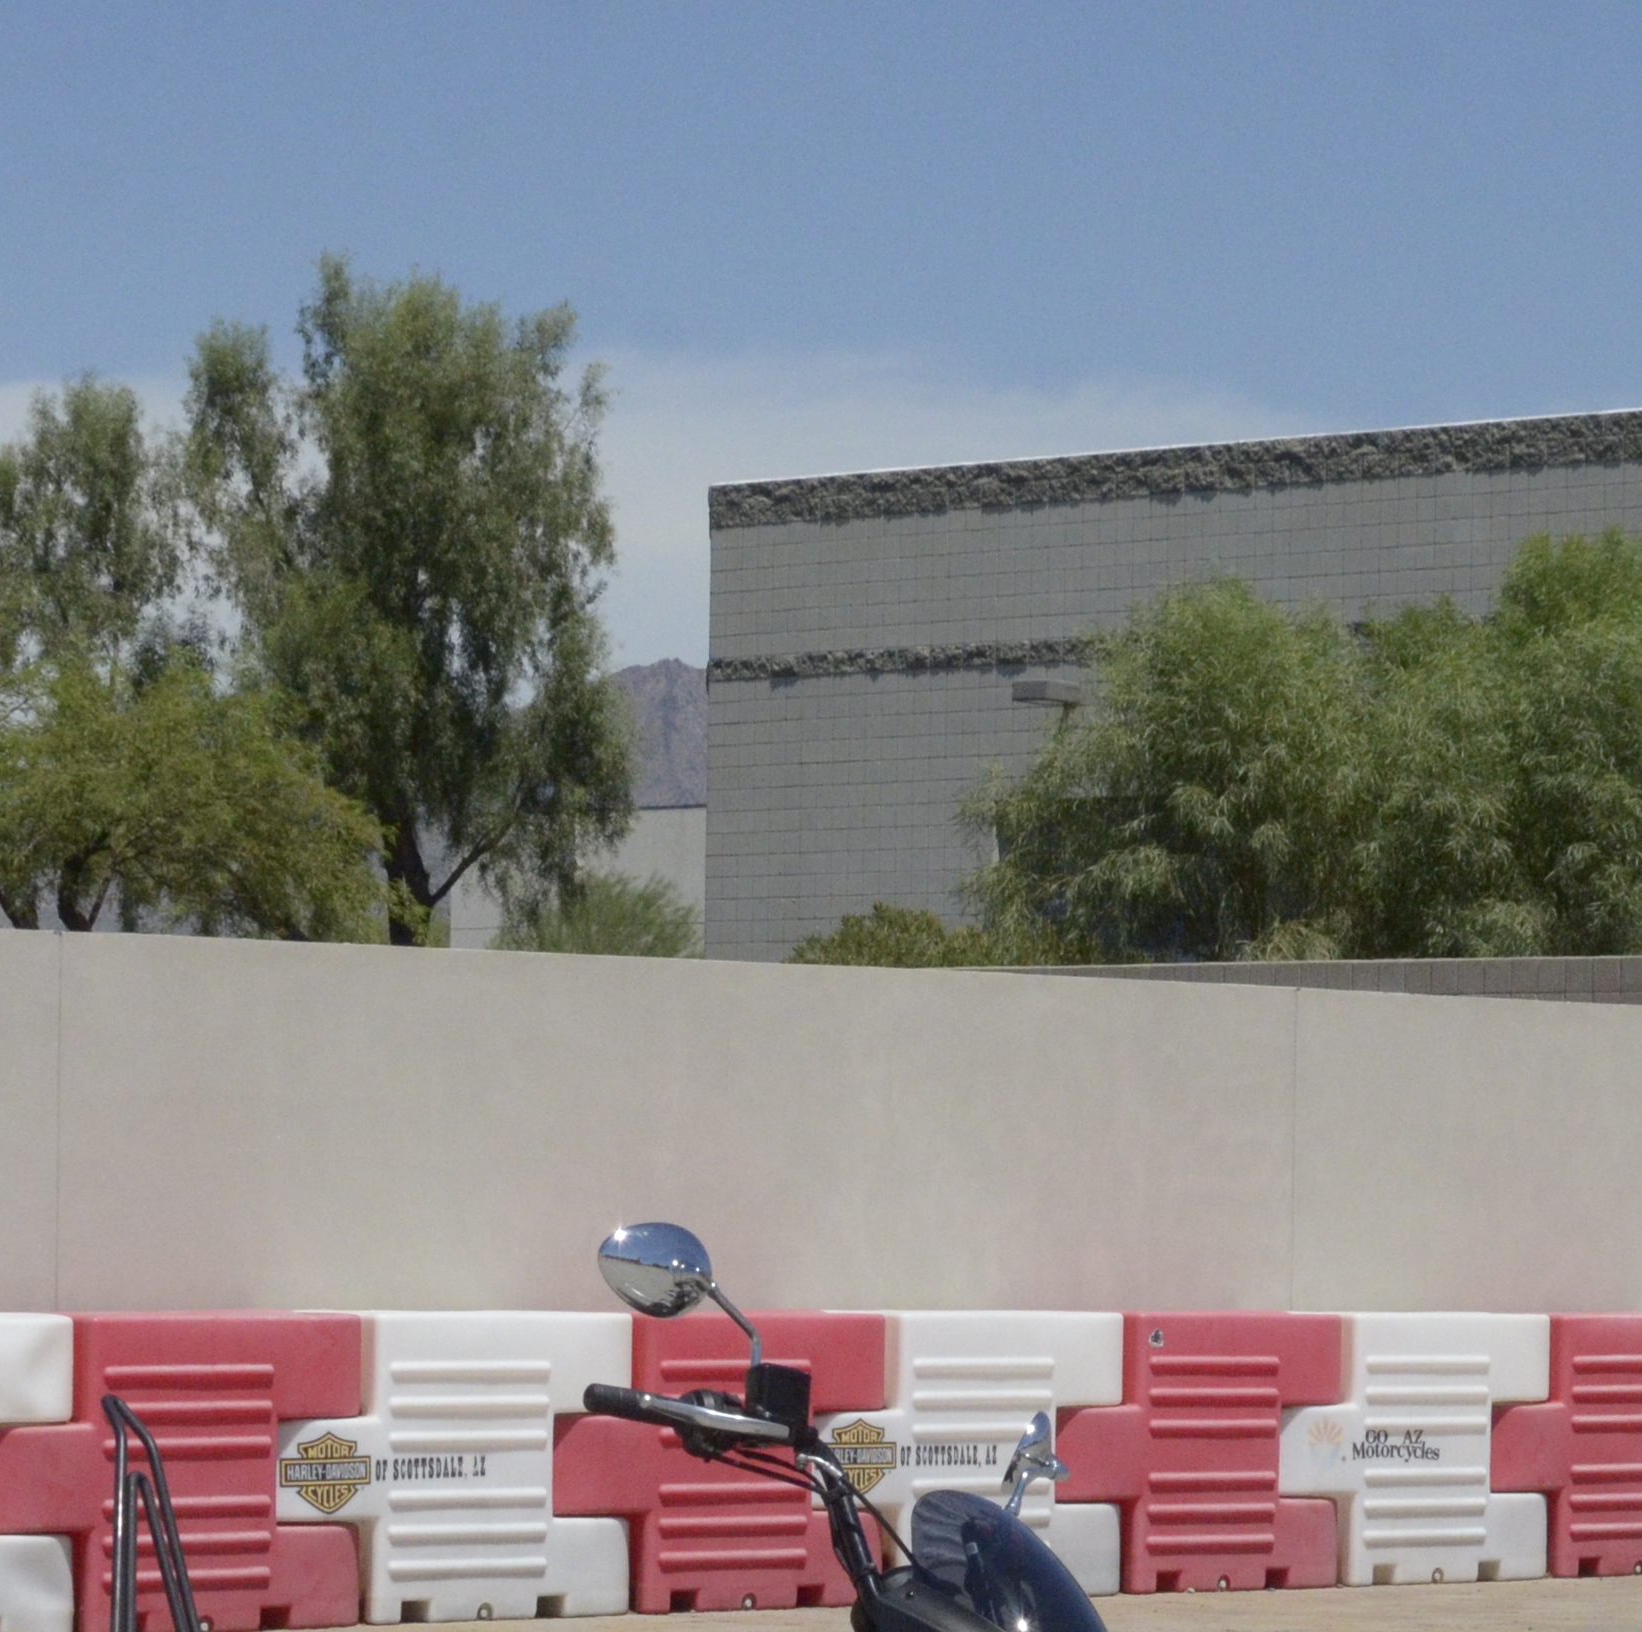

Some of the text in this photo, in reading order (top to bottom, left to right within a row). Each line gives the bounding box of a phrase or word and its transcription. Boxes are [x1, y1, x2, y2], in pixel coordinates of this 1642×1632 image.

[841, 1426, 878, 1443] MOTOR
[1365, 1429, 1424, 1445] GO AZ
[308, 1440, 350, 1459] MOTOR
[834, 1447, 893, 1464] RLEY-DAVIDSON
[900, 1444, 997, 1468] OF SCOTTSDALE, AZ
[1352, 1441, 1441, 1463] Motorcycles
[286, 1462, 367, 1481] HARLEY-DAVIDSON
[375, 1459, 389, 1482] OF
[472, 1455, 486, 1477] AZ
[845, 1468, 878, 1489] YCLES
[308, 1485, 350, 1507] CYCLES
